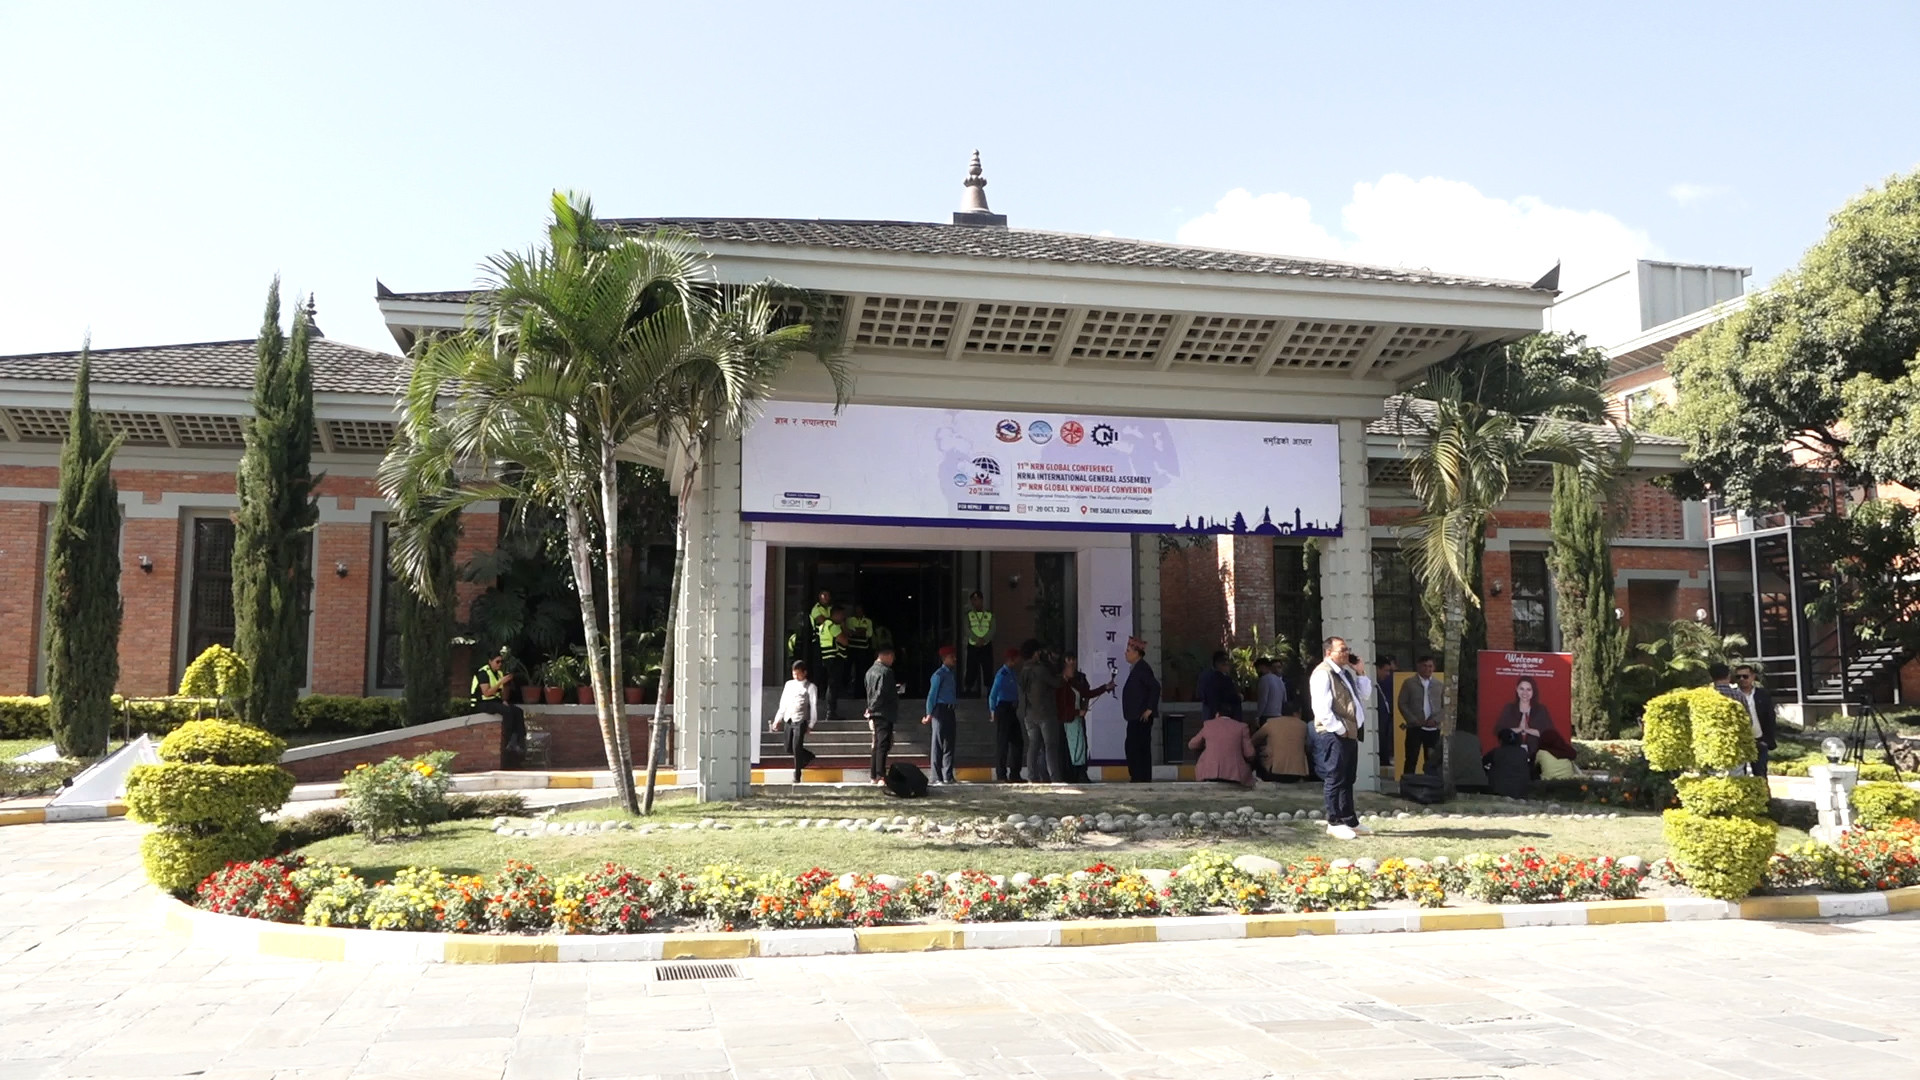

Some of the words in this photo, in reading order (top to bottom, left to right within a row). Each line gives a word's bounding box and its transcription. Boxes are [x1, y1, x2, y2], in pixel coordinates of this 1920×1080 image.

[1030, 463, 1045, 471] NRN
[1046, 463, 1071, 472] GLOBAL
[1071, 464, 1114, 473] CONFERENCE
[1037, 473, 1087, 482] INTERNATIONAL
[1088, 475, 1117, 483] GENERAL
[1118, 476, 1151, 484] ASSEMBLY
[1044, 484, 1069, 492] GLOBAL
[1070, 485, 1110, 493] KNOWLEDGE
[1111, 486, 1152, 494] CONVENTION
[1504, 653, 1544, 664] Welcome
